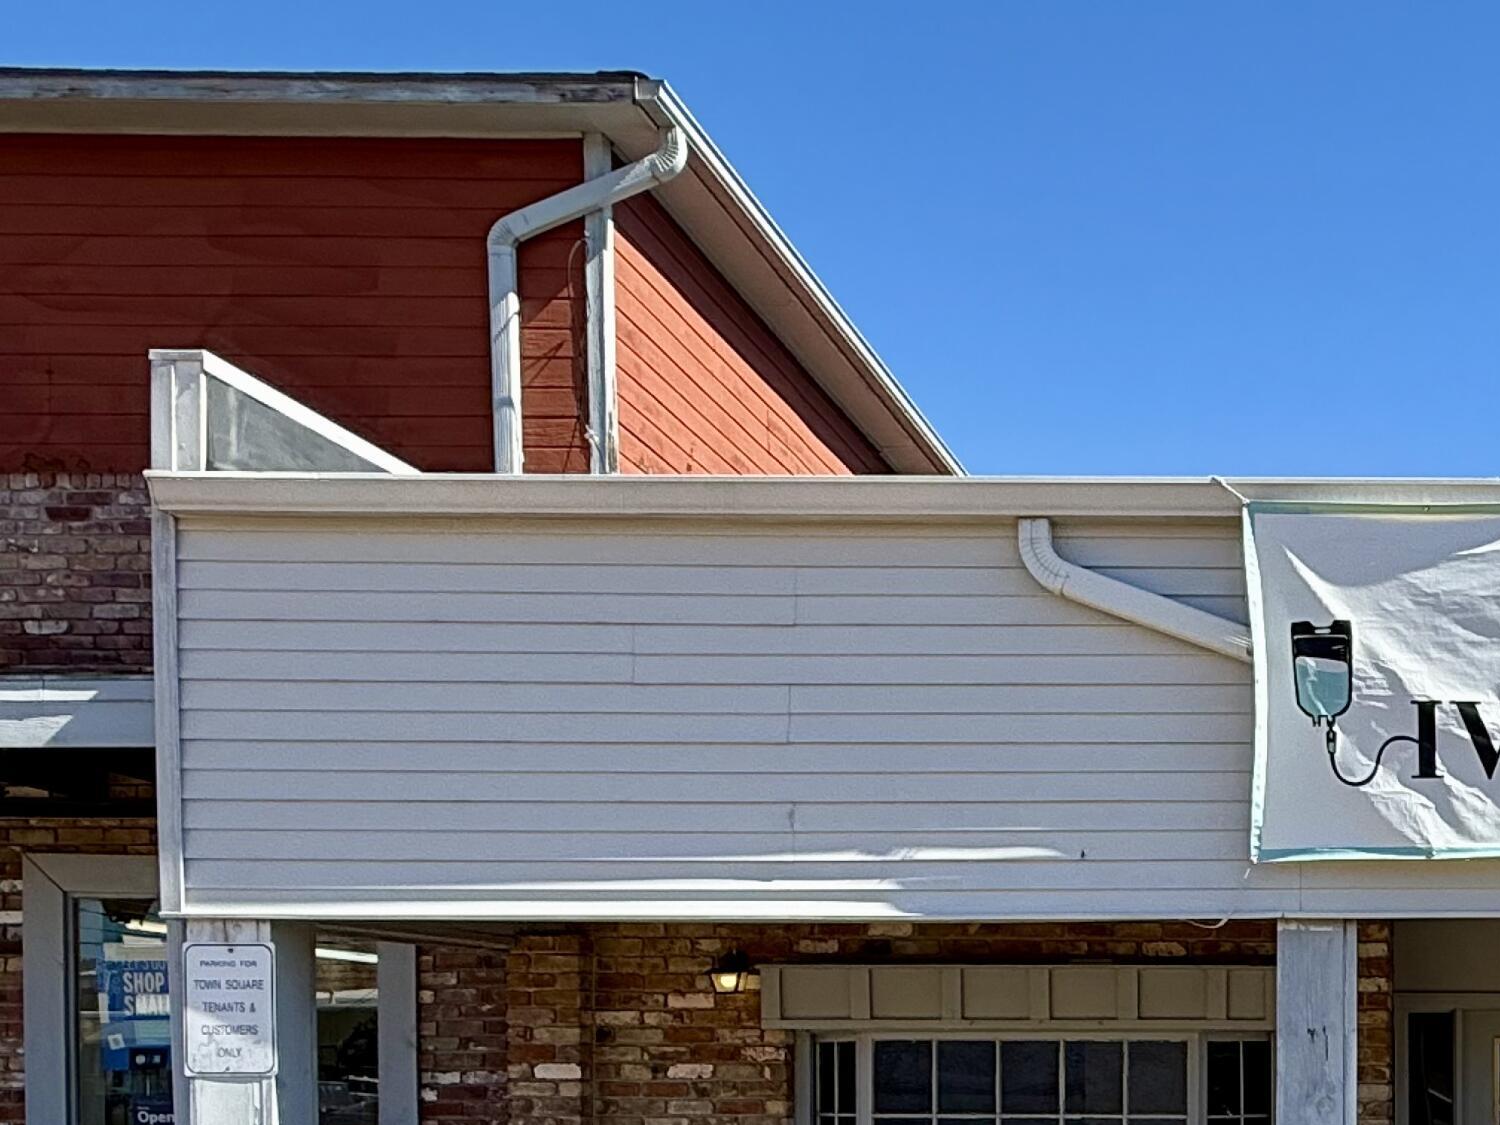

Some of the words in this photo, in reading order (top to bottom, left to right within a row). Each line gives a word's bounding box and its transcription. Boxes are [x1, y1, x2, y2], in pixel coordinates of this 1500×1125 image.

[200, 960, 237, 968] PARKING
[240, 960, 257, 968] FOR
[123, 971, 164, 993] SHOP
[193, 979, 222, 990] TOWN
[225, 979, 265, 990] SQUARE
[202, 1001, 246, 1013] TENANTS
[249, 1002, 256, 1013] &
[201, 1024, 259, 1035] CUSTOMERS
[217, 1047, 242, 1058] ONLY
[137, 1110, 175, 1125] Open
